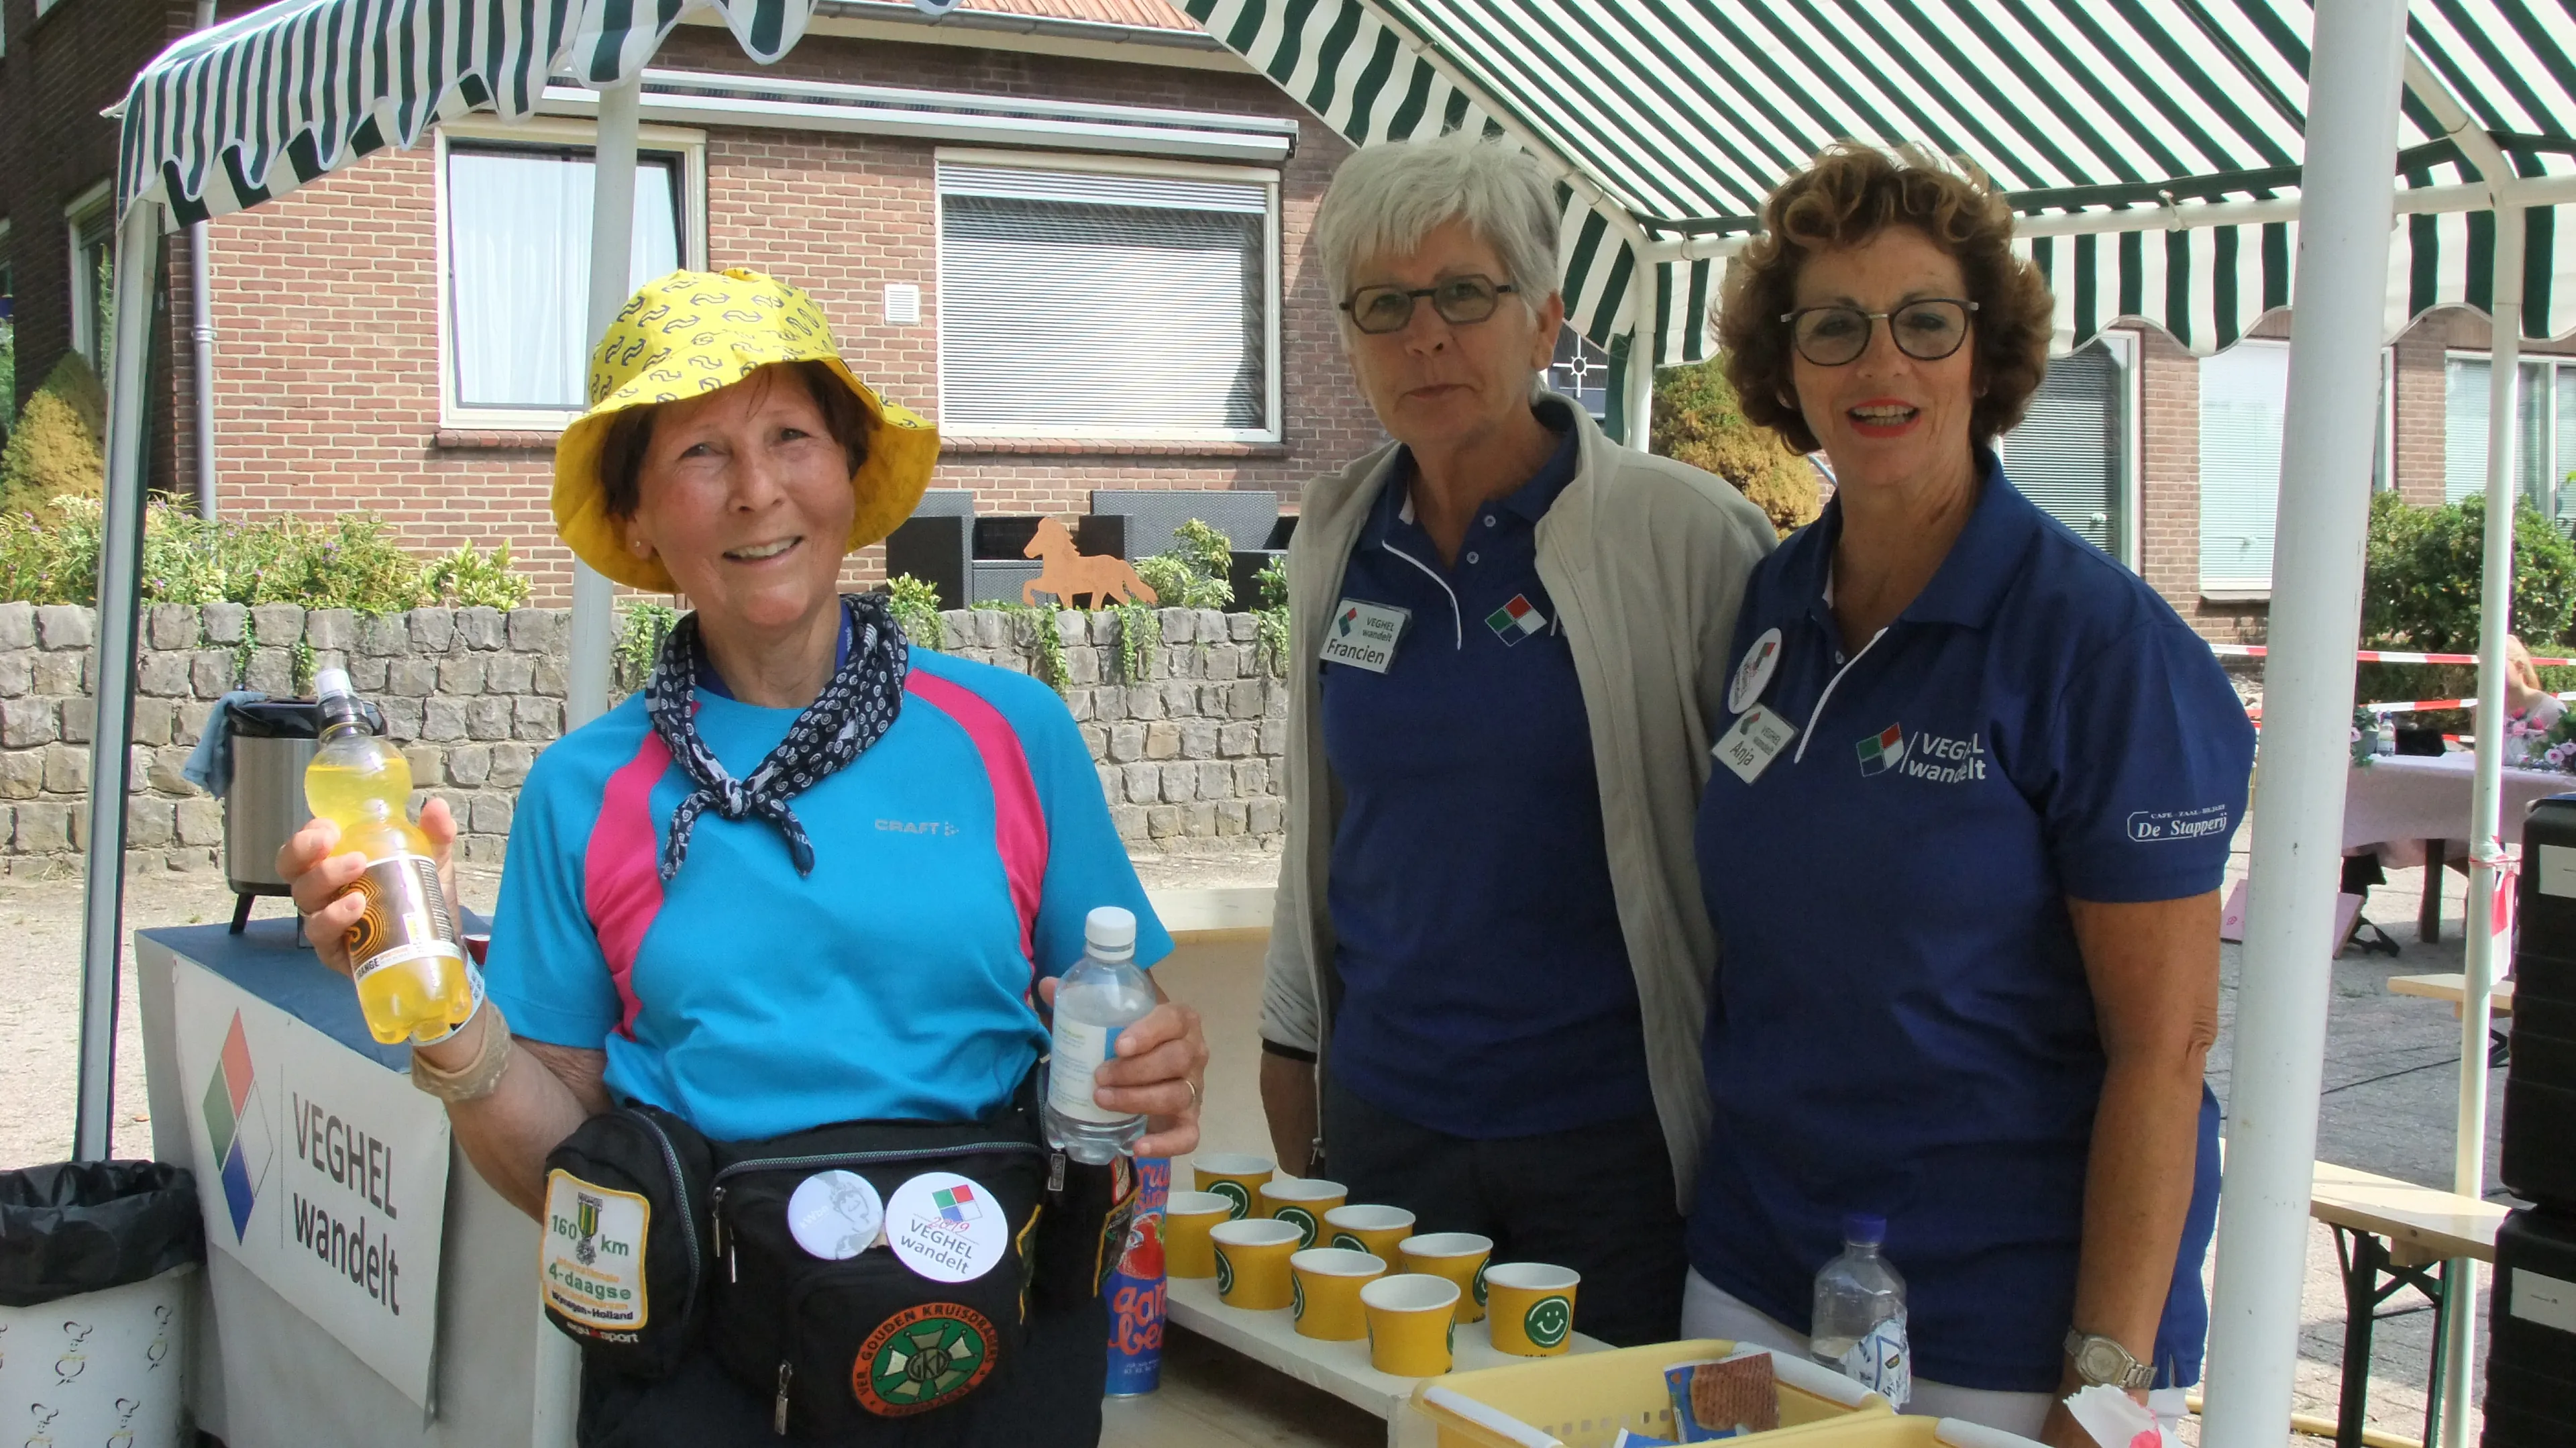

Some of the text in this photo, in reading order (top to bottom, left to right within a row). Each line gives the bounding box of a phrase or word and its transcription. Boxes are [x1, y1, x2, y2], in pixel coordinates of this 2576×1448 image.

[1362, 629, 1392, 642] wandelt
[1367, 617, 1394, 631] VEGHEL
[1327, 638, 1385, 664] Francien
[1729, 740, 1755, 766] Anja
[1923, 732, 1985, 760] VEGL
[875, 819, 940, 835] CRAFT
[2137, 812, 2228, 838] De Stapperij
[292, 1092, 397, 1220] VEGHEL
[551, 1214, 629, 1256] 160 km
[910, 1218, 972, 1259] VEGHEL
[928, 1216, 971, 1234] 2019
[293, 1192, 400, 1316] wandelt
[900, 1235, 969, 1275] wandelt
[548, 1261, 631, 1300] 4-daagse
[861, 1311, 916, 1360] GOUDEN
